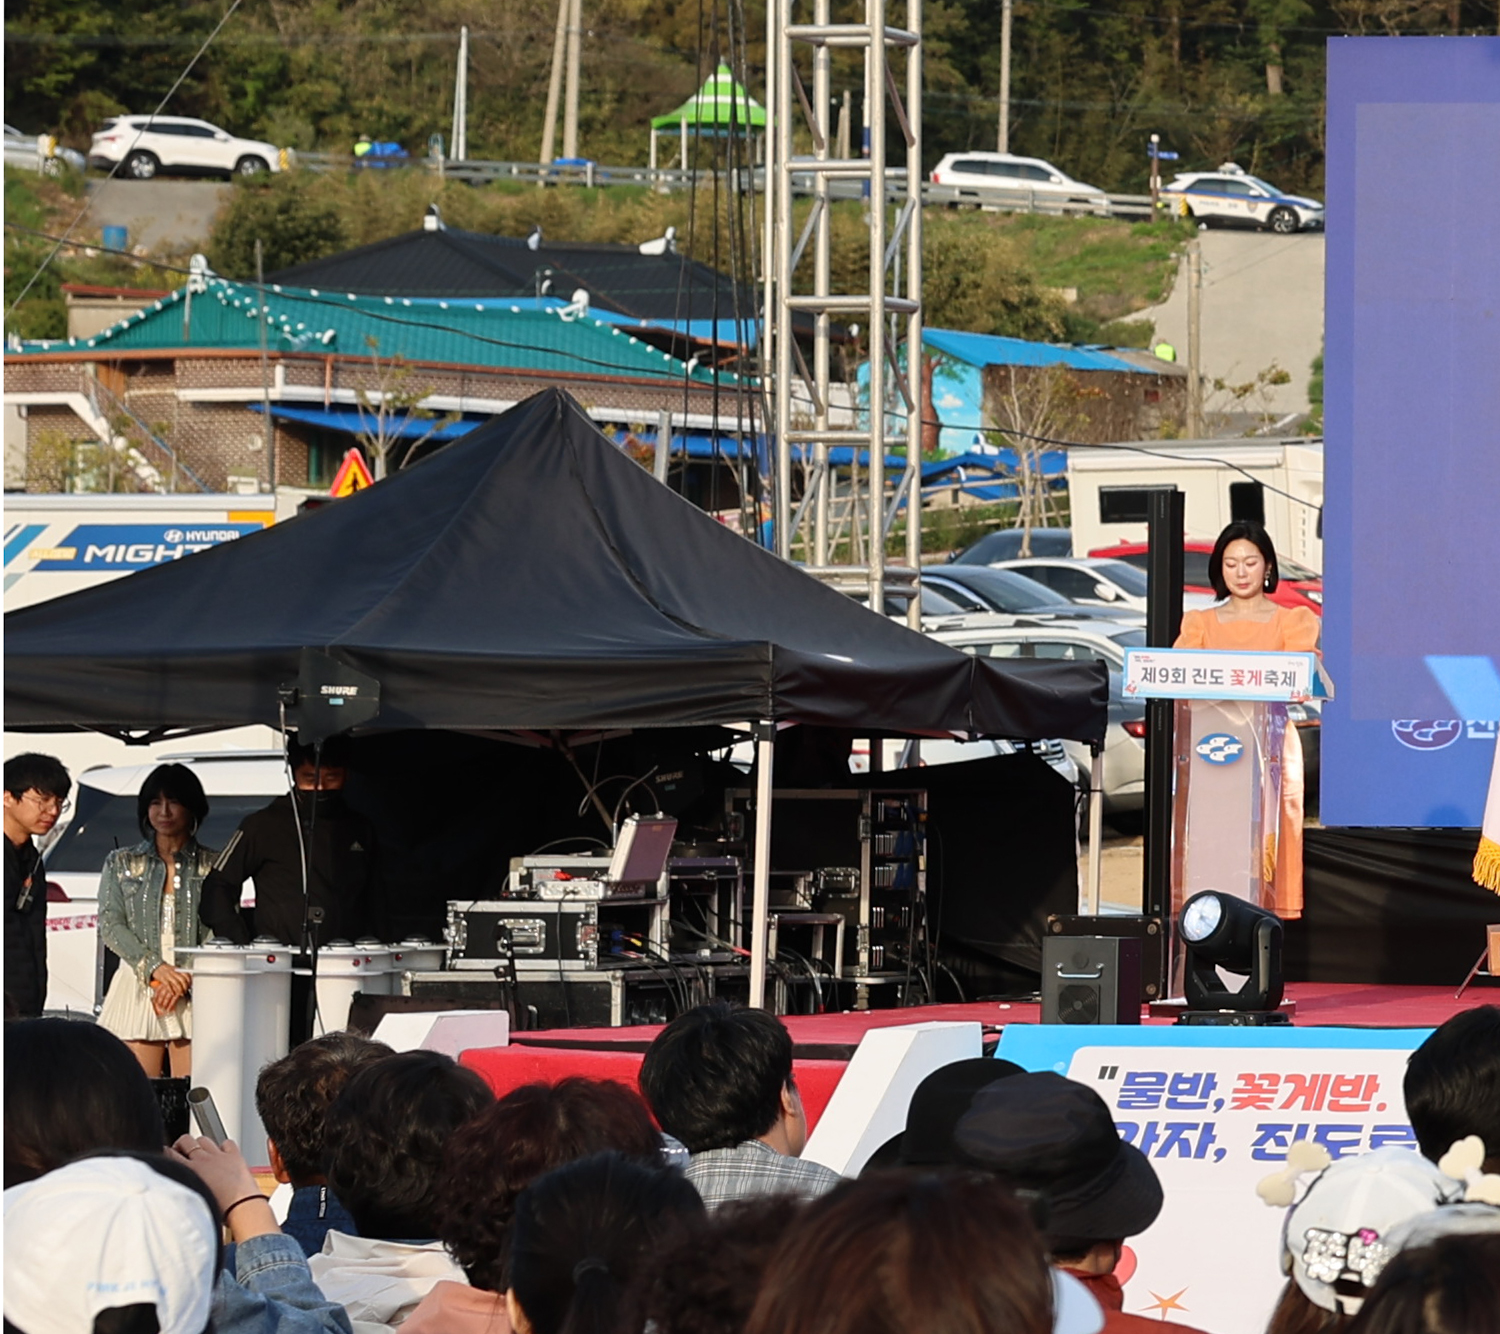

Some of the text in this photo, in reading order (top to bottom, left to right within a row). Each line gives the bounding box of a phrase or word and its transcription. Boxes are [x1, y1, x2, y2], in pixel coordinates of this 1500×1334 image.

[1140, 666, 1297, 687] 제9회 진도 꽃게축제
[320, 685, 359, 696] SHURE
